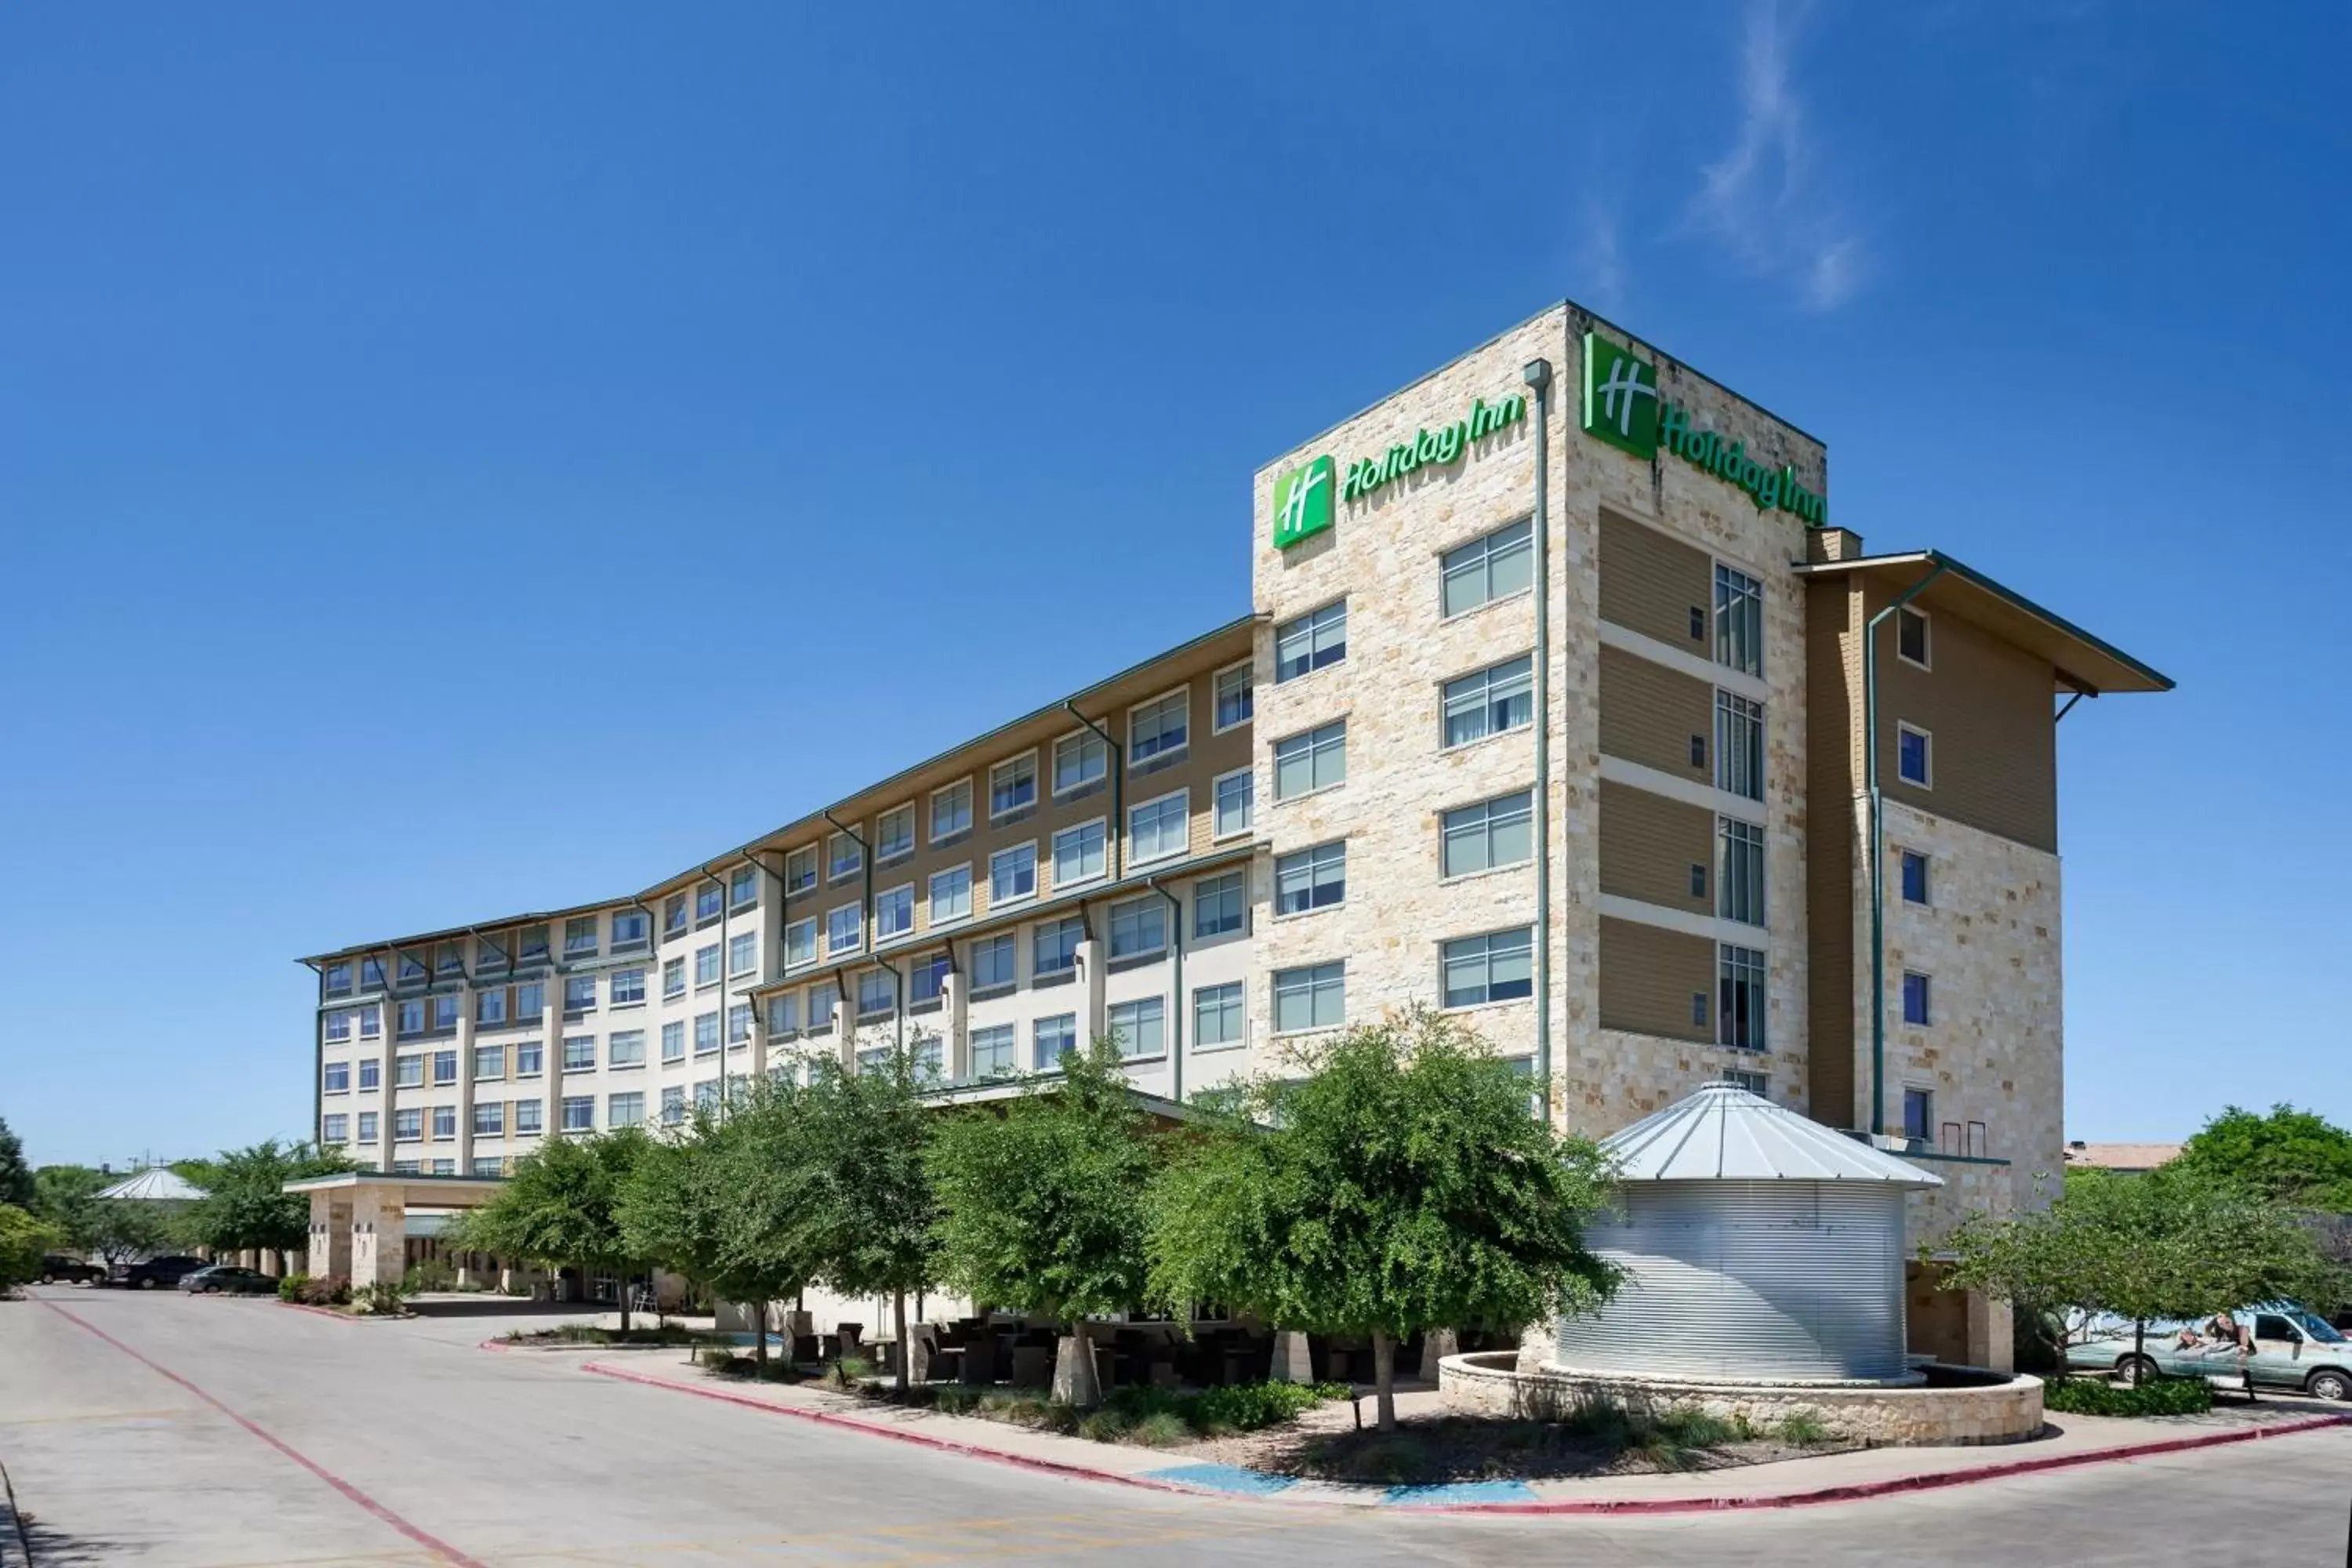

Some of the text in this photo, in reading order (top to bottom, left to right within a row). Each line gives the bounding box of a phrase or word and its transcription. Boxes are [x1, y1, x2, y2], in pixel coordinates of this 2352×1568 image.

[1597, 356, 1657, 437] H
[1341, 394, 1526, 502] Holiday Inn
[1660, 401, 1827, 526] Holiday Inn
[1279, 465, 1327, 532] H
